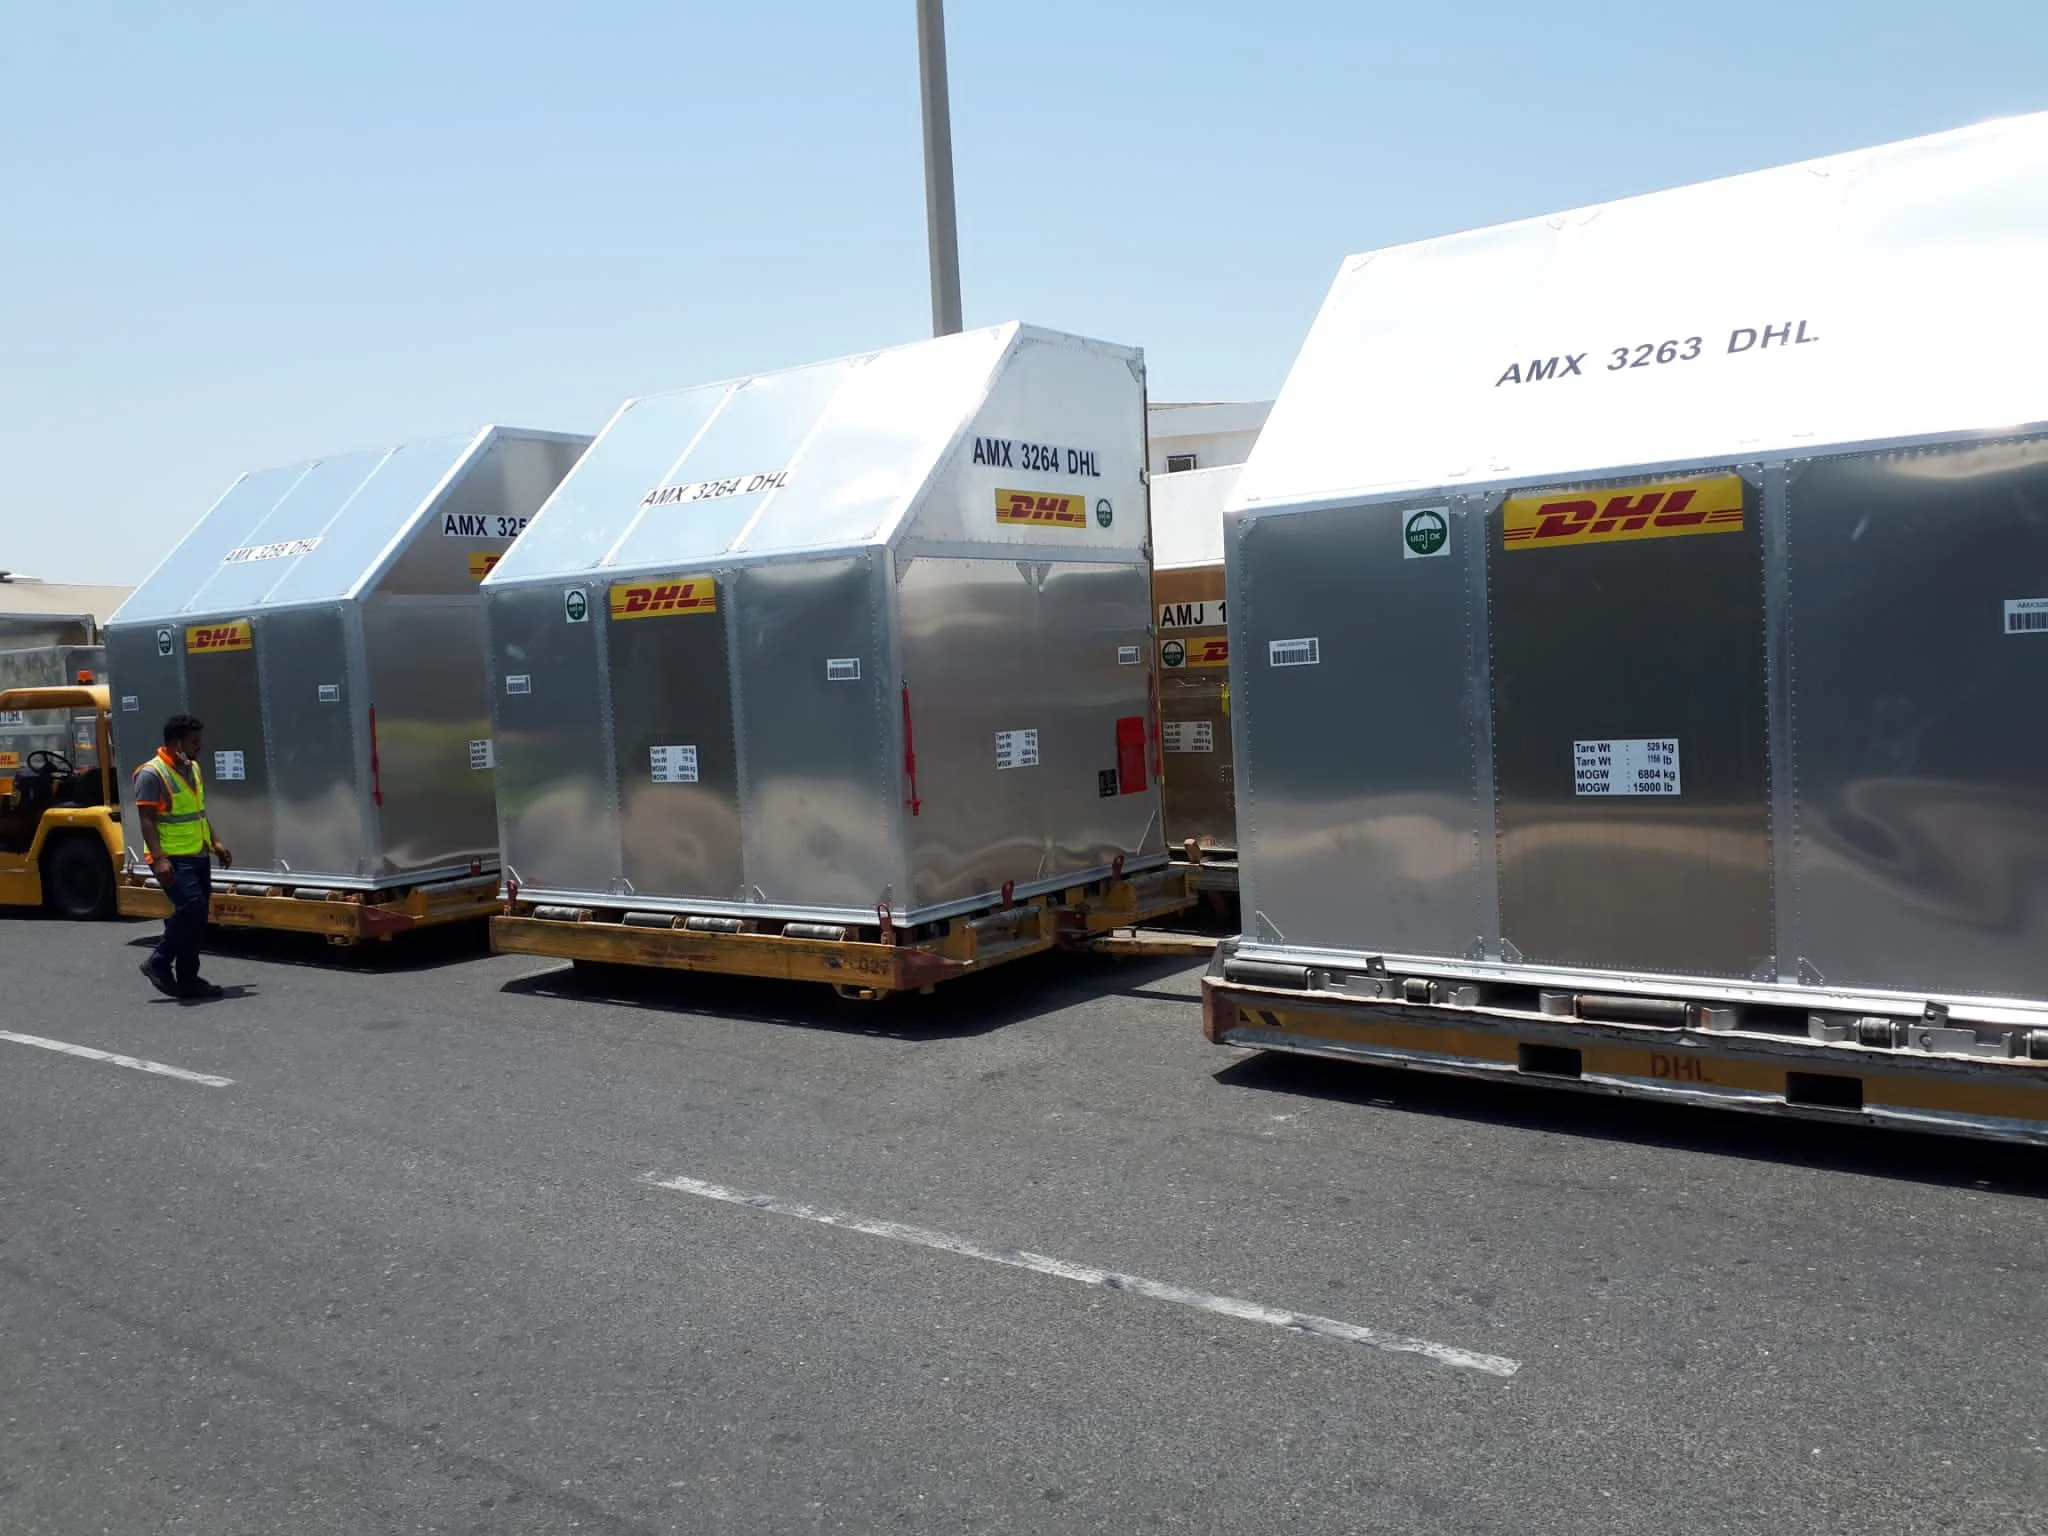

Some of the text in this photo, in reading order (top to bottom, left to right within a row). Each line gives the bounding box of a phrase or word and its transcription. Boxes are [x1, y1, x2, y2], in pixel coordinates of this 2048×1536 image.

[1494, 320, 1819, 387] AMX 3263 DHL
[973, 437, 1101, 477] AMX 3264 DHL
[640, 472, 788, 507] AMX 3264 DHL
[1009, 495, 1075, 521] DHL
[1533, 490, 1709, 538] DHL
[445, 514, 488, 536] AMX
[1410, 532, 1441, 543] ULD OK
[226, 549, 256, 561] AMX
[288, 538, 318, 555] DHL
[625, 584, 699, 612] DHL
[1161, 603, 1204, 626] AMJ
[195, 627, 241, 648] DHL
[1576, 743, 1595, 752] Tare
[1598, 743, 1611, 752] Wt
[1647, 742, 1660, 751] 529
[1662, 742, 1674, 753] kg
[1576, 757, 1596, 766] Tare
[1598, 757, 1611, 766] Wt
[1663, 755, 1672, 765] lb
[1577, 770, 1609, 779] MOGW
[1638, 770, 1660, 779] 6804
[1663, 769, 1676, 781] kg
[1577, 783, 1610, 792] MOGW
[1633, 783, 1661, 792] 15000
[1664, 783, 1673, 792] lb
[1650, 1054, 1715, 1082] DHL
